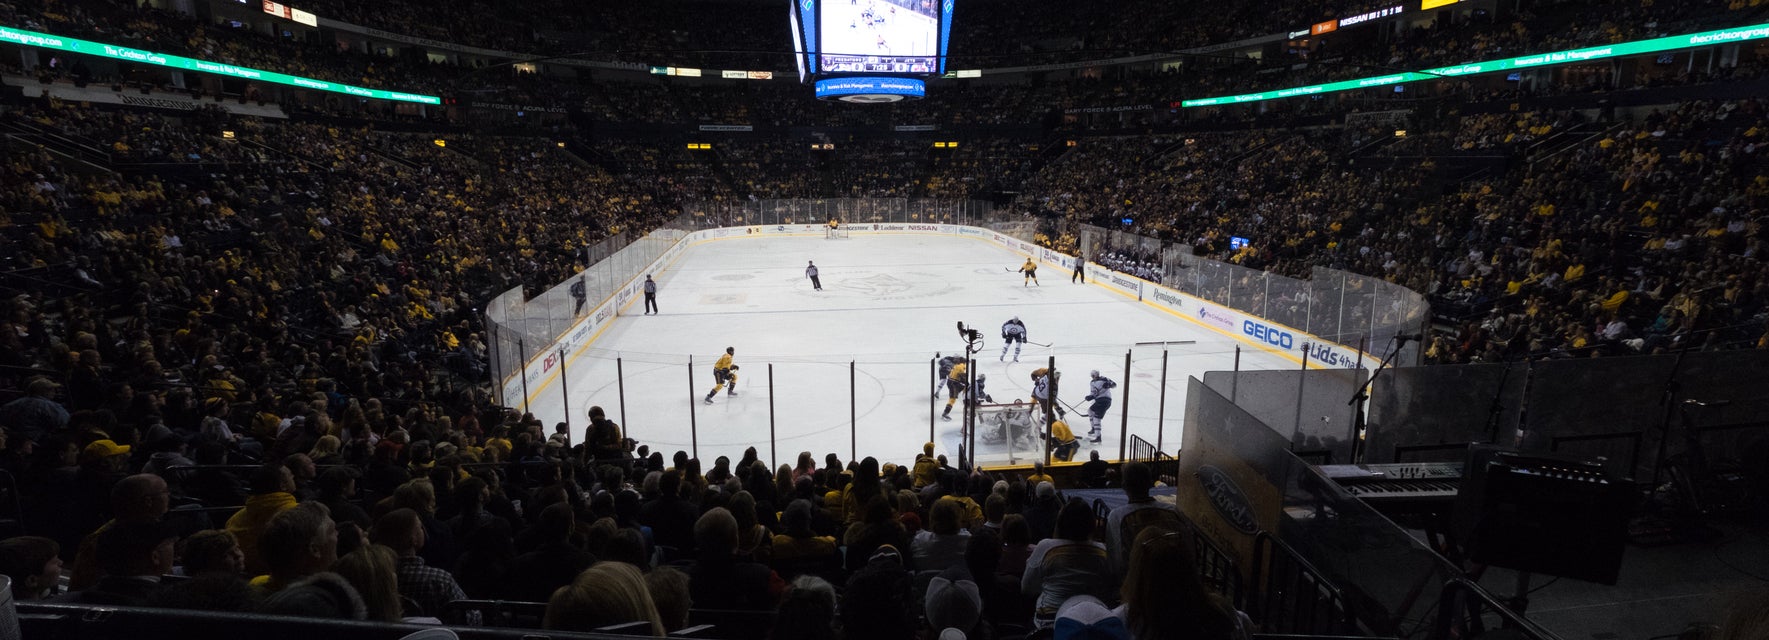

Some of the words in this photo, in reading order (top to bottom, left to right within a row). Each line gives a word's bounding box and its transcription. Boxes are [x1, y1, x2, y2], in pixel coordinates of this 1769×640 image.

[1340, 13, 1368, 27] NISSAN
[104, 45, 118, 56] The
[118, 48, 147, 60] Crichton
[147, 52, 167, 65] Group
[1514, 56, 1544, 66] Insurance
[1545, 54, 1551, 62] &
[1552, 52, 1566, 61] Risk
[1567, 48, 1612, 60] Management
[1463, 64, 1482, 73] Group
[1152, 288, 1183, 306] Remington
[1243, 319, 1293, 350] GEICO
[543, 351, 557, 374] DEX
[1310, 342, 1338, 366] Lids
[1205, 471, 1247, 525] Ford
